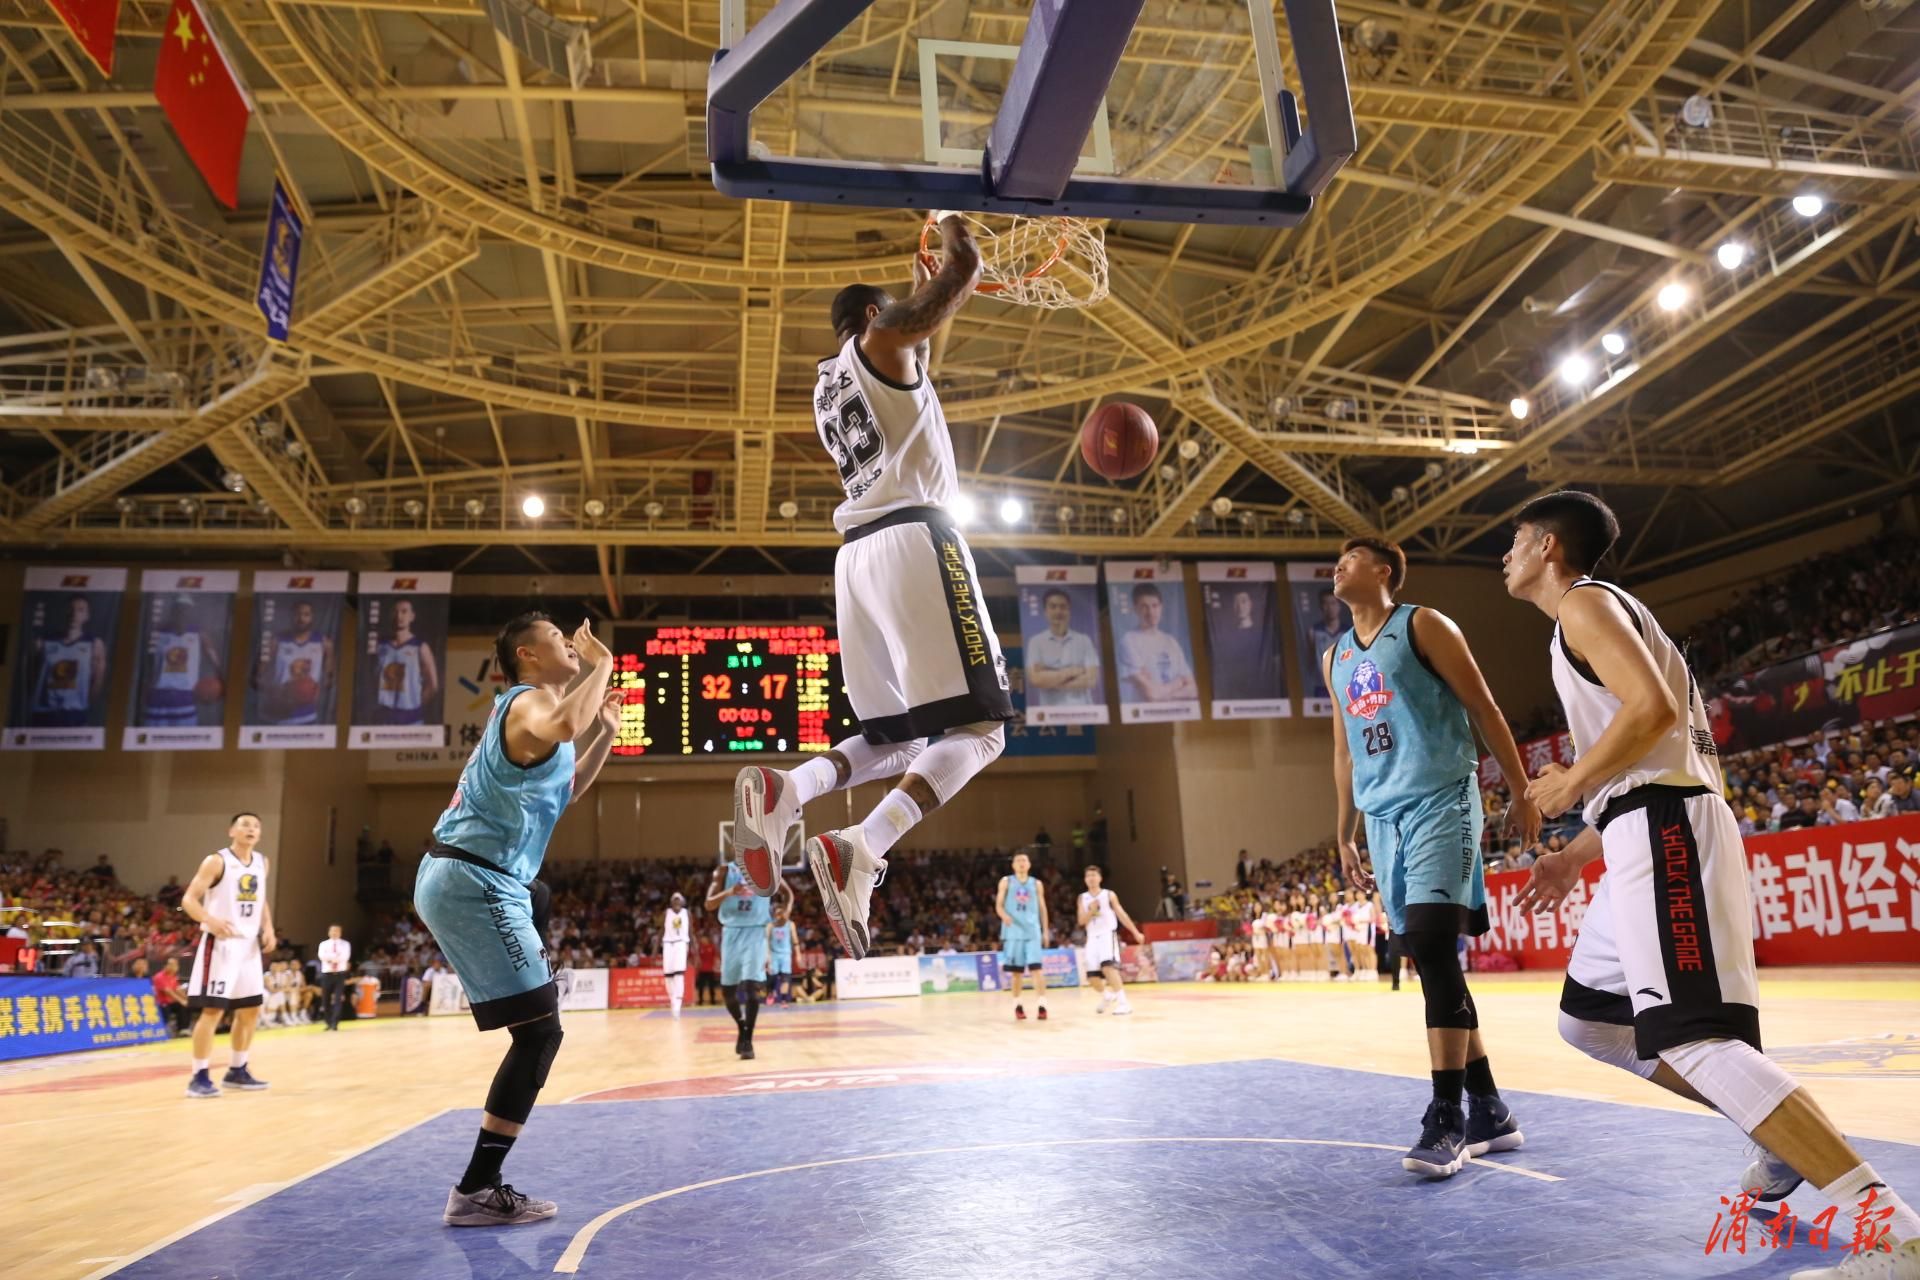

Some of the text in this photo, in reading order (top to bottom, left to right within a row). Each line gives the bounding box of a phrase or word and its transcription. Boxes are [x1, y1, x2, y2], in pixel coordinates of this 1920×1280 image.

[942, 542, 987, 666] SHOCK THE GAME
[702, 674, 732, 700] 32
[759, 674, 788, 700] 17
[1362, 721, 1394, 756] 28
[396, 751, 440, 762] CHINA
[1461, 820, 1473, 846] THE
[1461, 847, 1473, 884] GAME
[240, 903, 253, 917] 13
[1662, 823, 1703, 971] SHOCK THE GAME
[18, 948, 37, 971] 4
[209, 980, 226, 995] 13
[729, 1074, 898, 1091] ANTA
